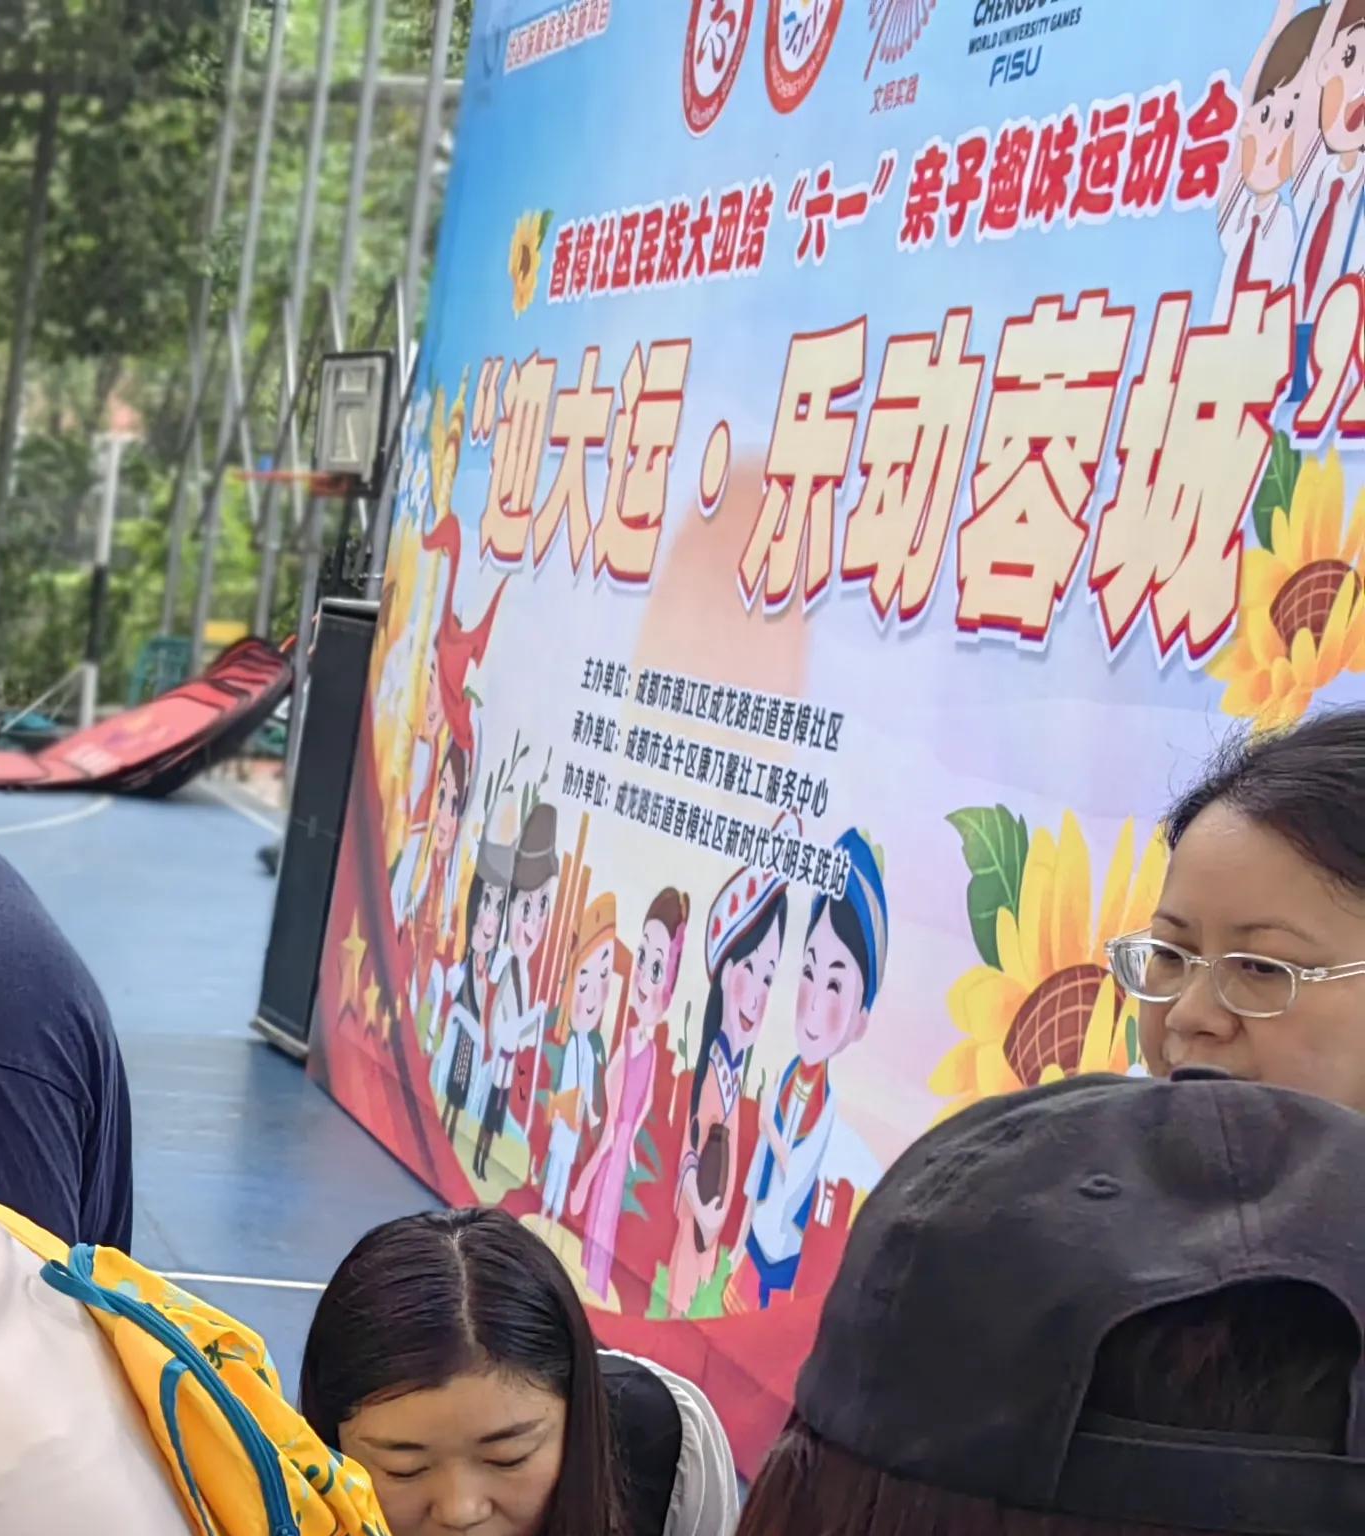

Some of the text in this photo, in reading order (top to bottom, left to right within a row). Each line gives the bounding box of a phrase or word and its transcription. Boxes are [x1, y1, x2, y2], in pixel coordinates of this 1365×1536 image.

[968, 7, 1082, 55] WORLD UNIVERSITY GAMES
[989, 45, 1043, 87] FISU
